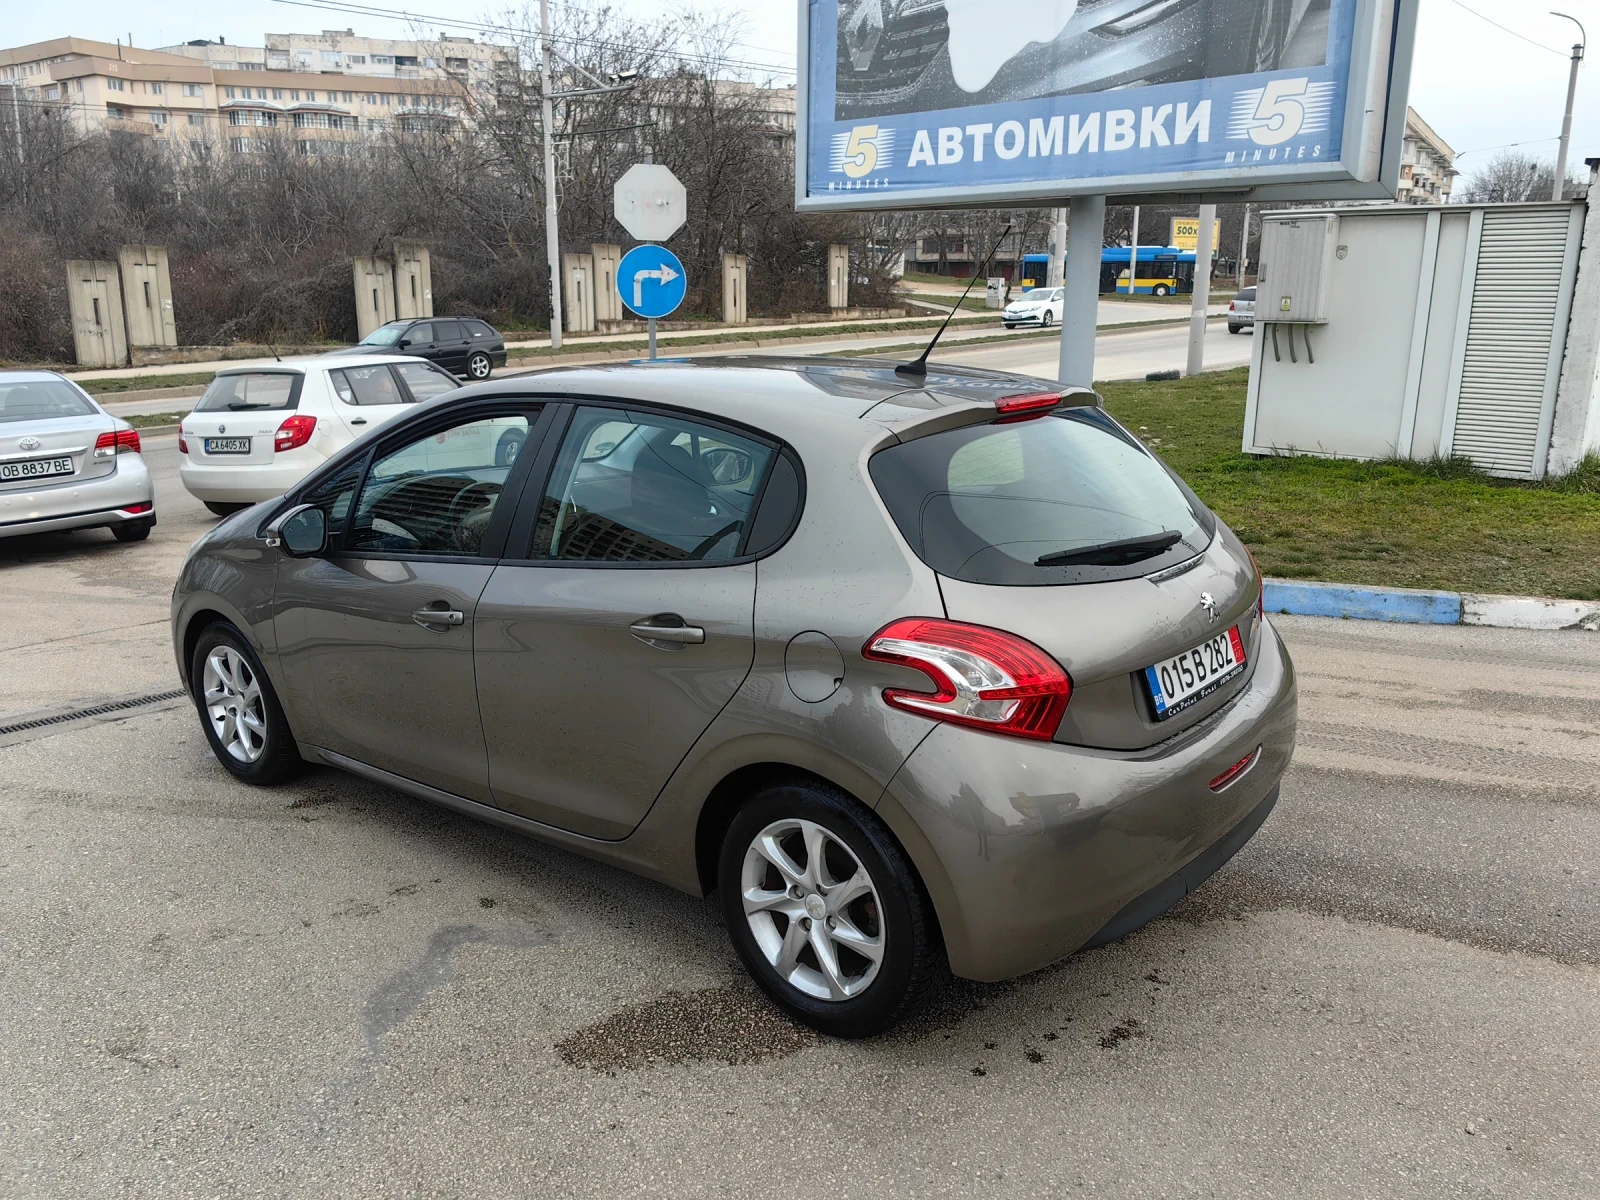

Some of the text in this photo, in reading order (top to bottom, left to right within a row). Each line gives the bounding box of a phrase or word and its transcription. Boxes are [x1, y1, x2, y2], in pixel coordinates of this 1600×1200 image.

[1247, 77, 1308, 146] 5
[907, 99, 1212, 167] АВТОМИВКИ
[841, 124, 879, 178] 5
[1224, 145, 1321, 163] MINUTES
[828, 178, 889, 191] MINUTES
[210, 440, 248, 450] CA 6405 XK
[22, 461, 51, 475] 8837
[54, 459, 71, 472] BE
[1161, 654, 1195, 699] 015
[1191, 649, 1207, 683] B
[1204, 633, 1233, 675] 282
[1154, 693, 1164, 706] BG
